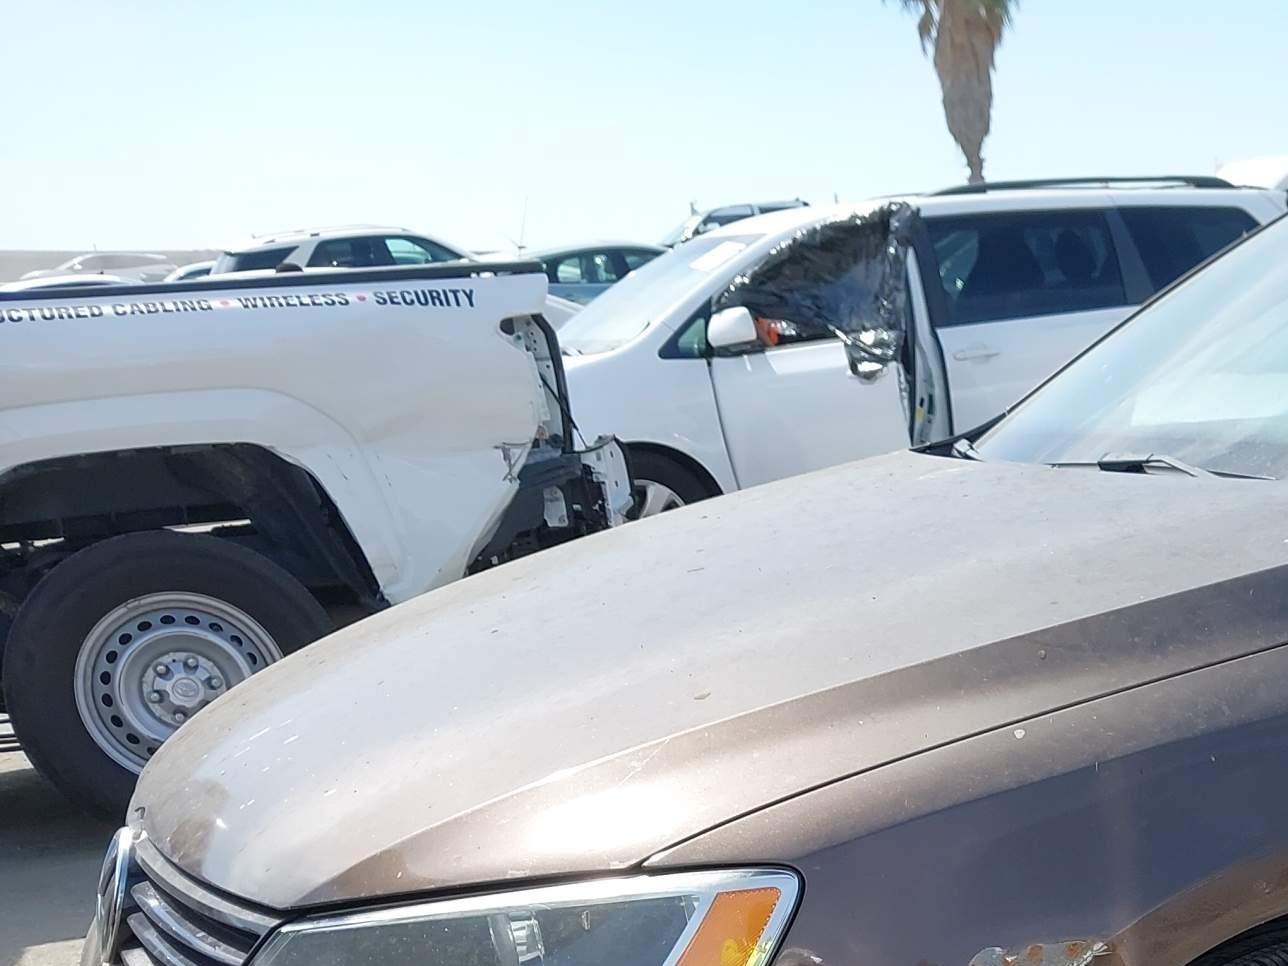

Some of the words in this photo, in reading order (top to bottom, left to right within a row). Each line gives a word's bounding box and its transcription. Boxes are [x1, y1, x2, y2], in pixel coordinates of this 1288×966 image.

[114, 299, 213, 316] CABLING
[237, 293, 350, 309] WIRELESS
[373, 289, 475, 307] SECURITY
